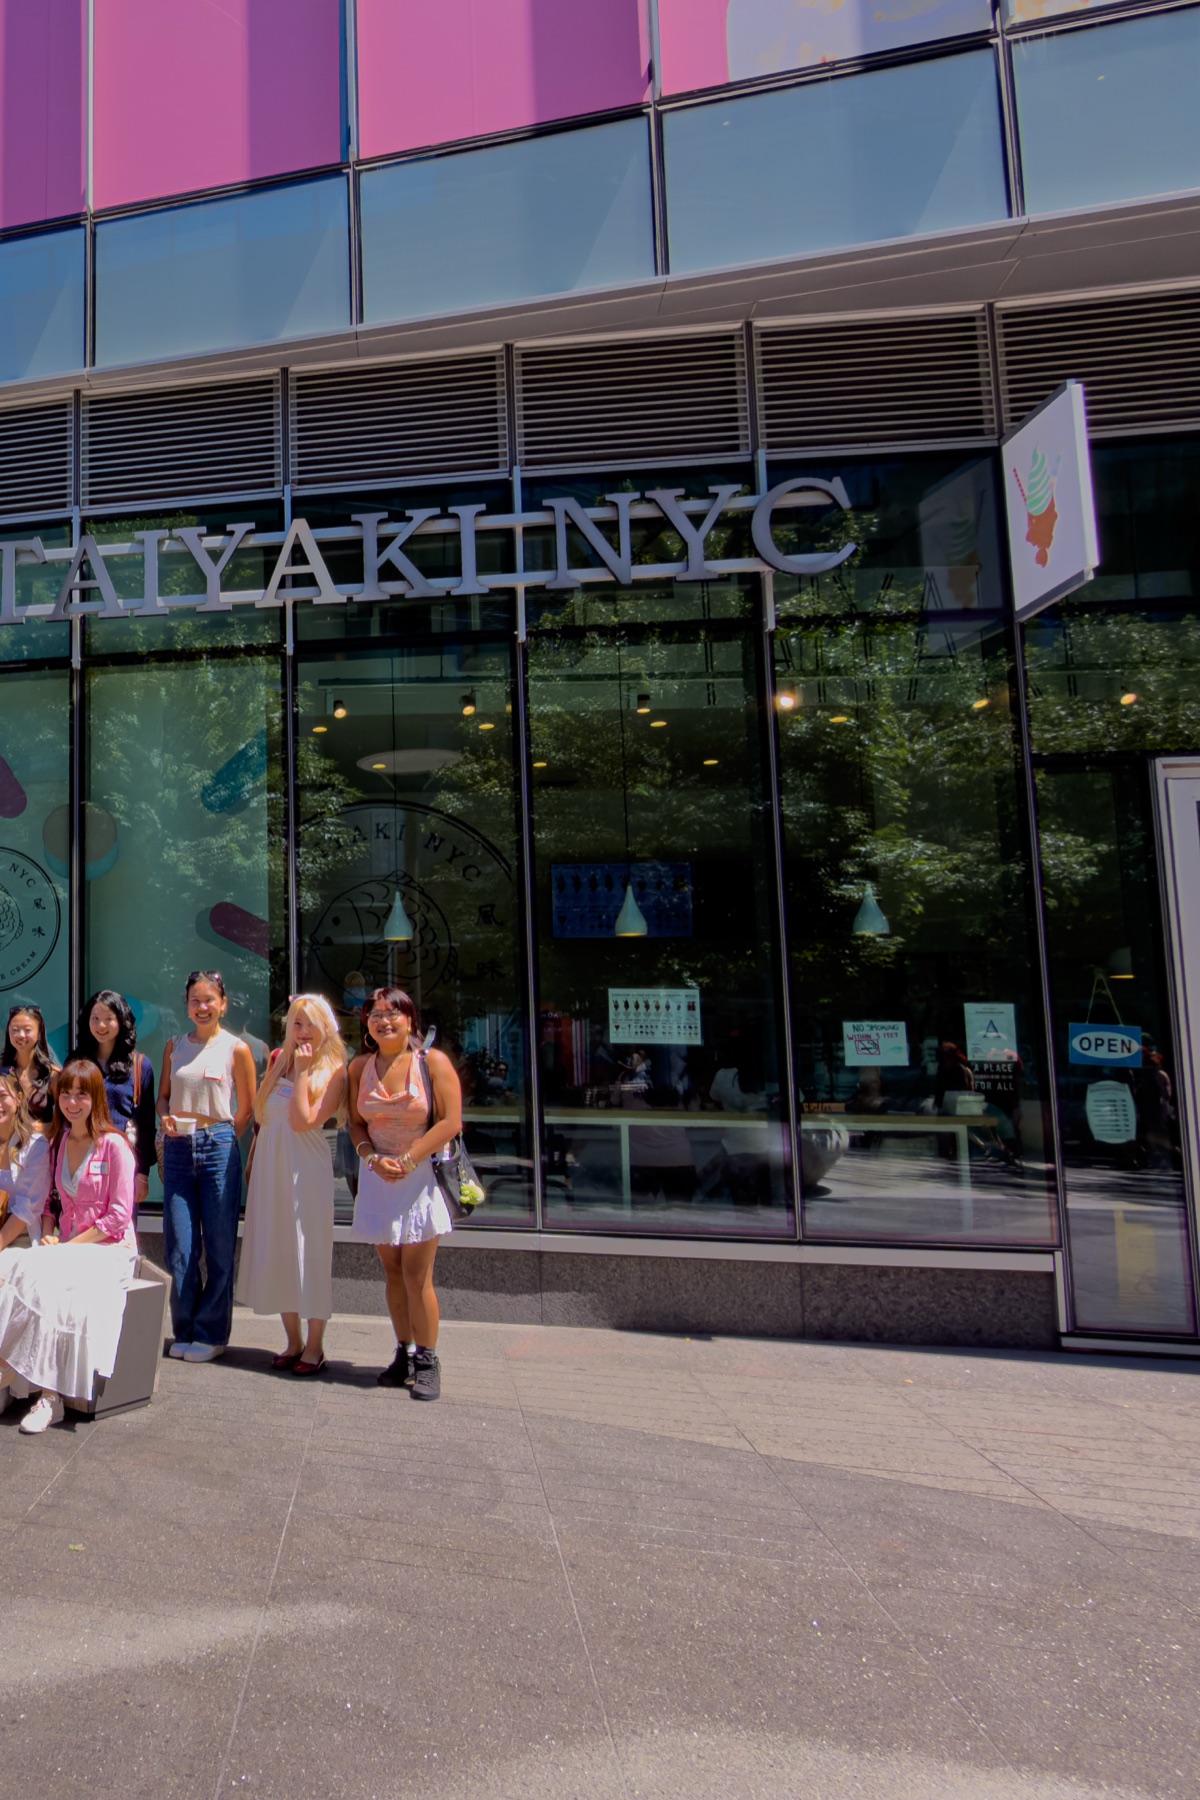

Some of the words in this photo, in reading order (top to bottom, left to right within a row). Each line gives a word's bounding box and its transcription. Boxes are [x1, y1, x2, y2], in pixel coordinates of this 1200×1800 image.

[542, 476, 858, 590] NYC
[423, 833, 482, 882] NYC
[8, 863, 36, 888] NYC
[10, 951, 37, 976] CREAM
[852, 1024, 865, 1033] NO
[982, 1019, 1002, 1038] A
[1079, 1036, 1132, 1054] OPEN
[973, 1064, 979, 1072] A
[983, 1064, 1013, 1072] PLACE
[975, 1081, 992, 1090] FOR
[997, 1082, 1014, 1091] ALL
